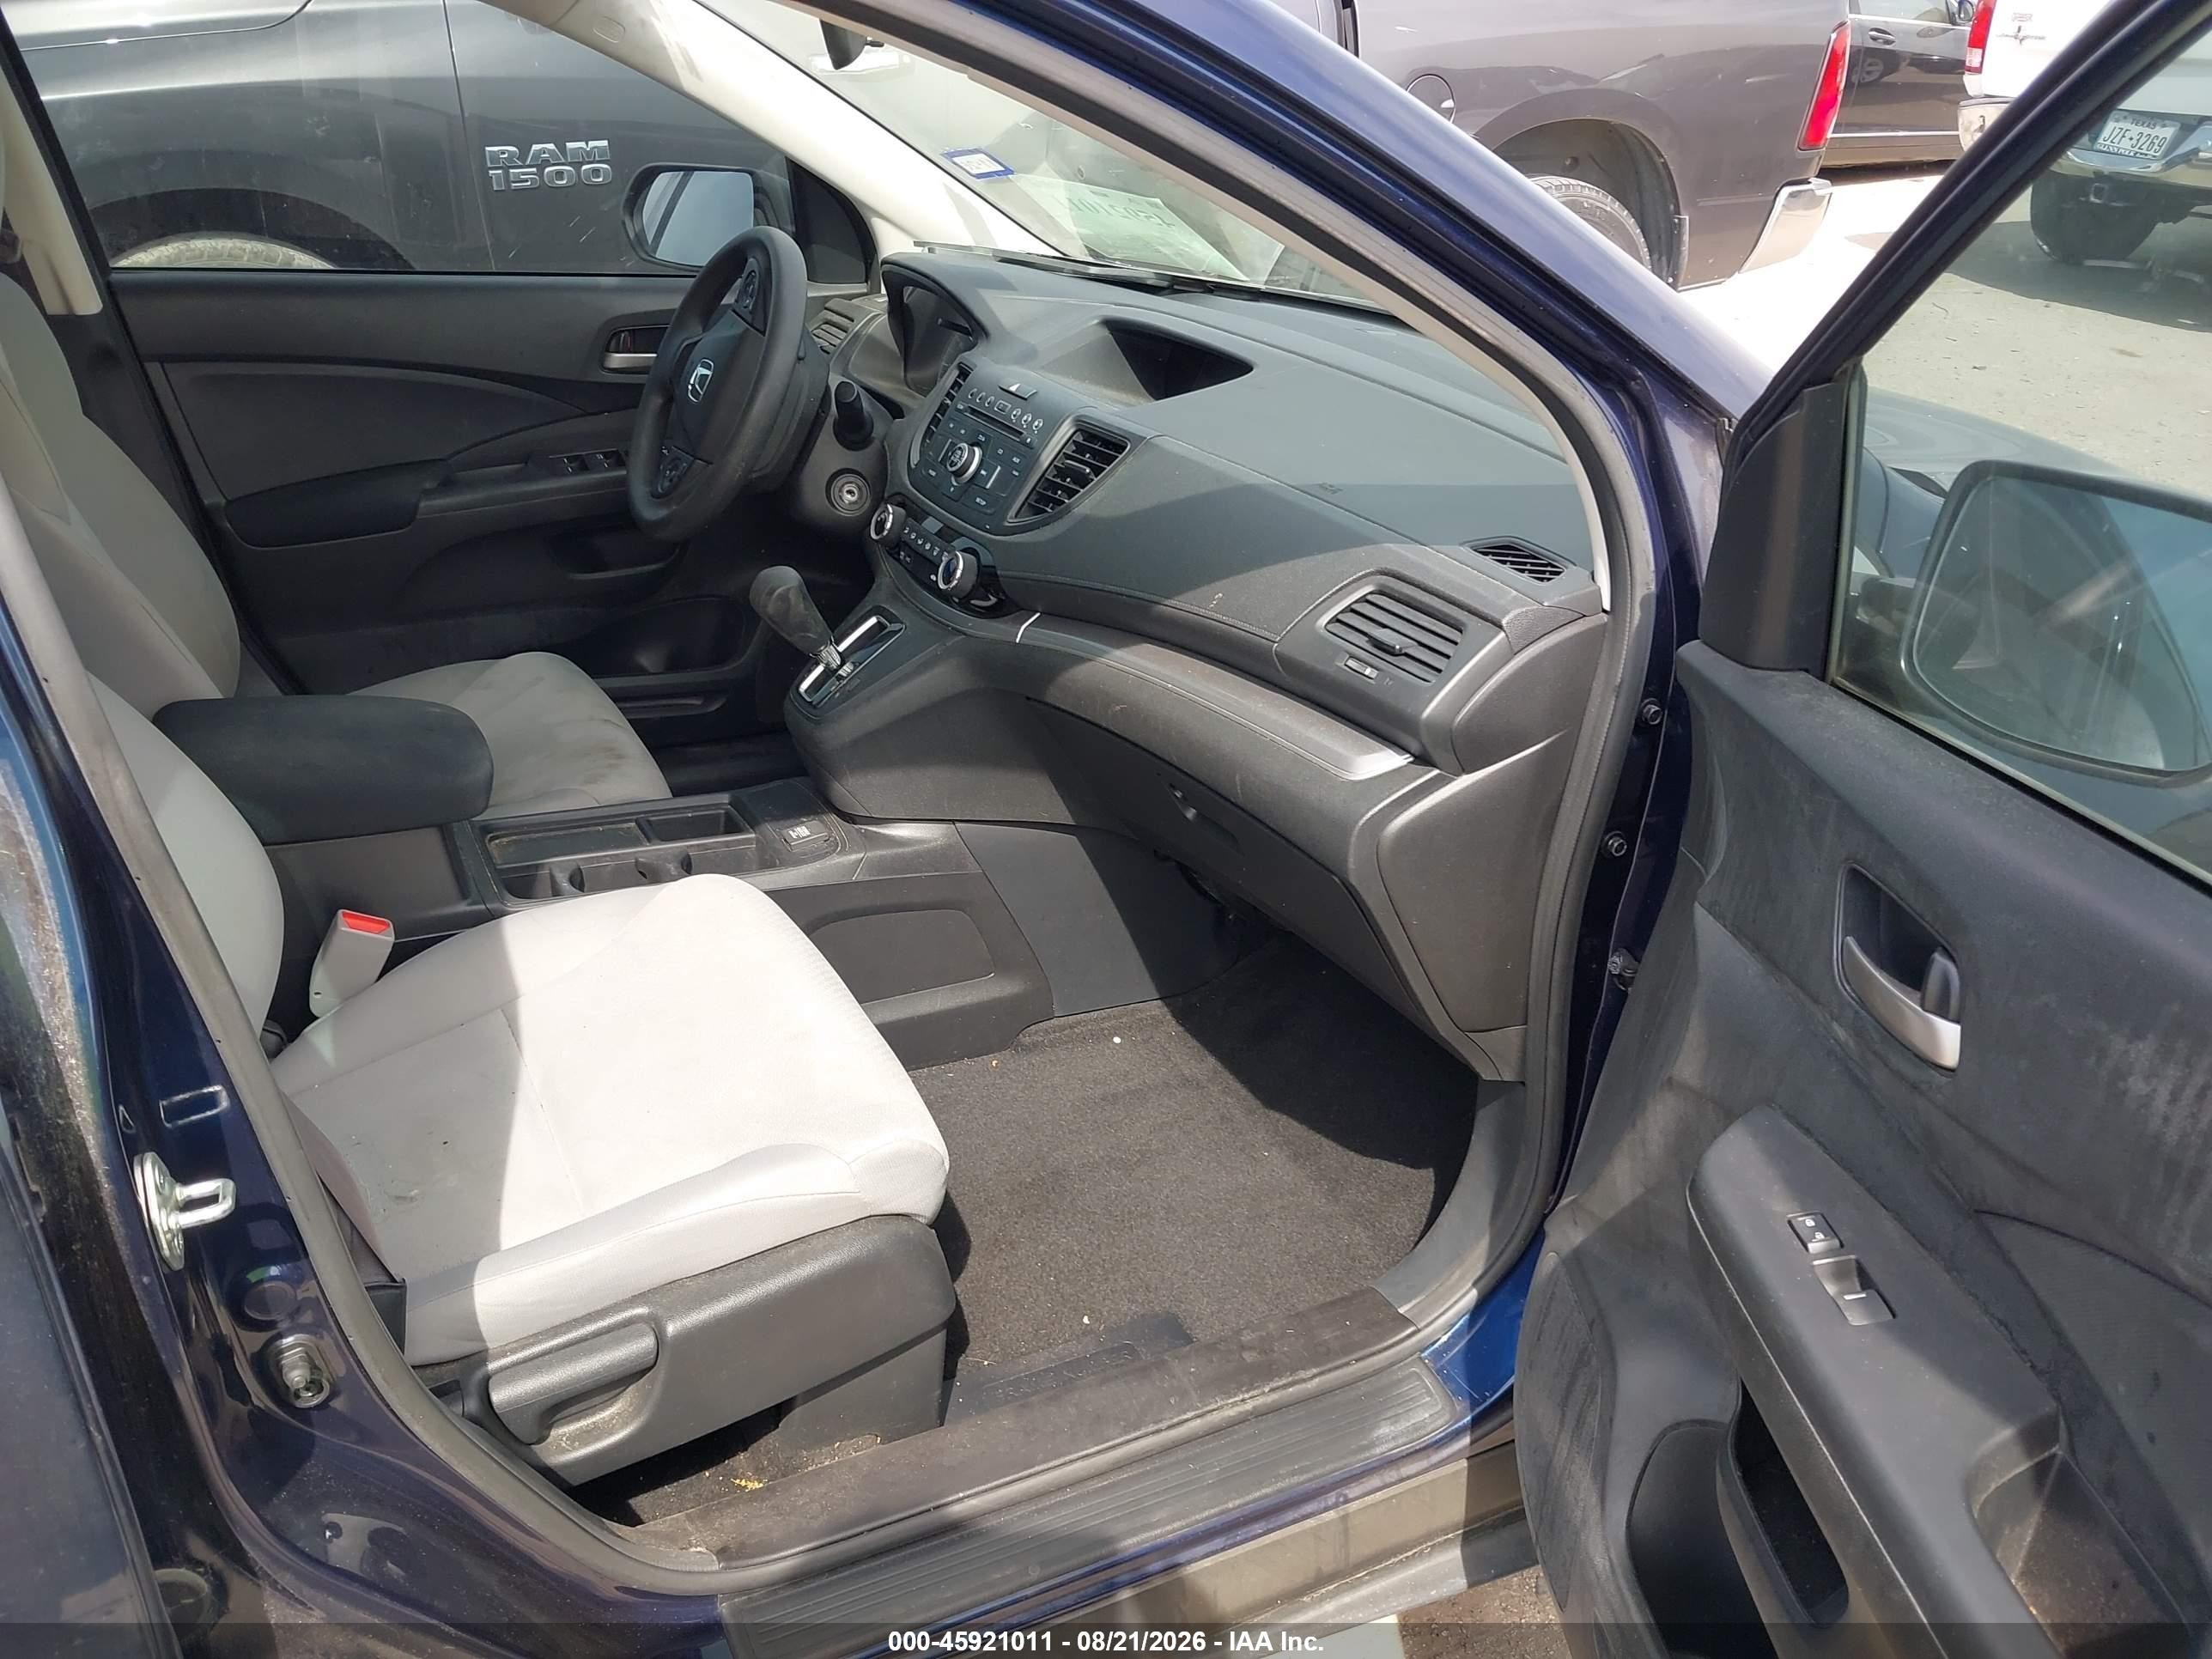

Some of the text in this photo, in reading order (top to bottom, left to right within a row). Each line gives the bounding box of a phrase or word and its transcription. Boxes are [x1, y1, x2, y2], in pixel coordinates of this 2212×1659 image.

[2130, 118, 2157, 130] TEXAS
[484, 139, 611, 167] RAM
[488, 163, 612, 191] 1500
